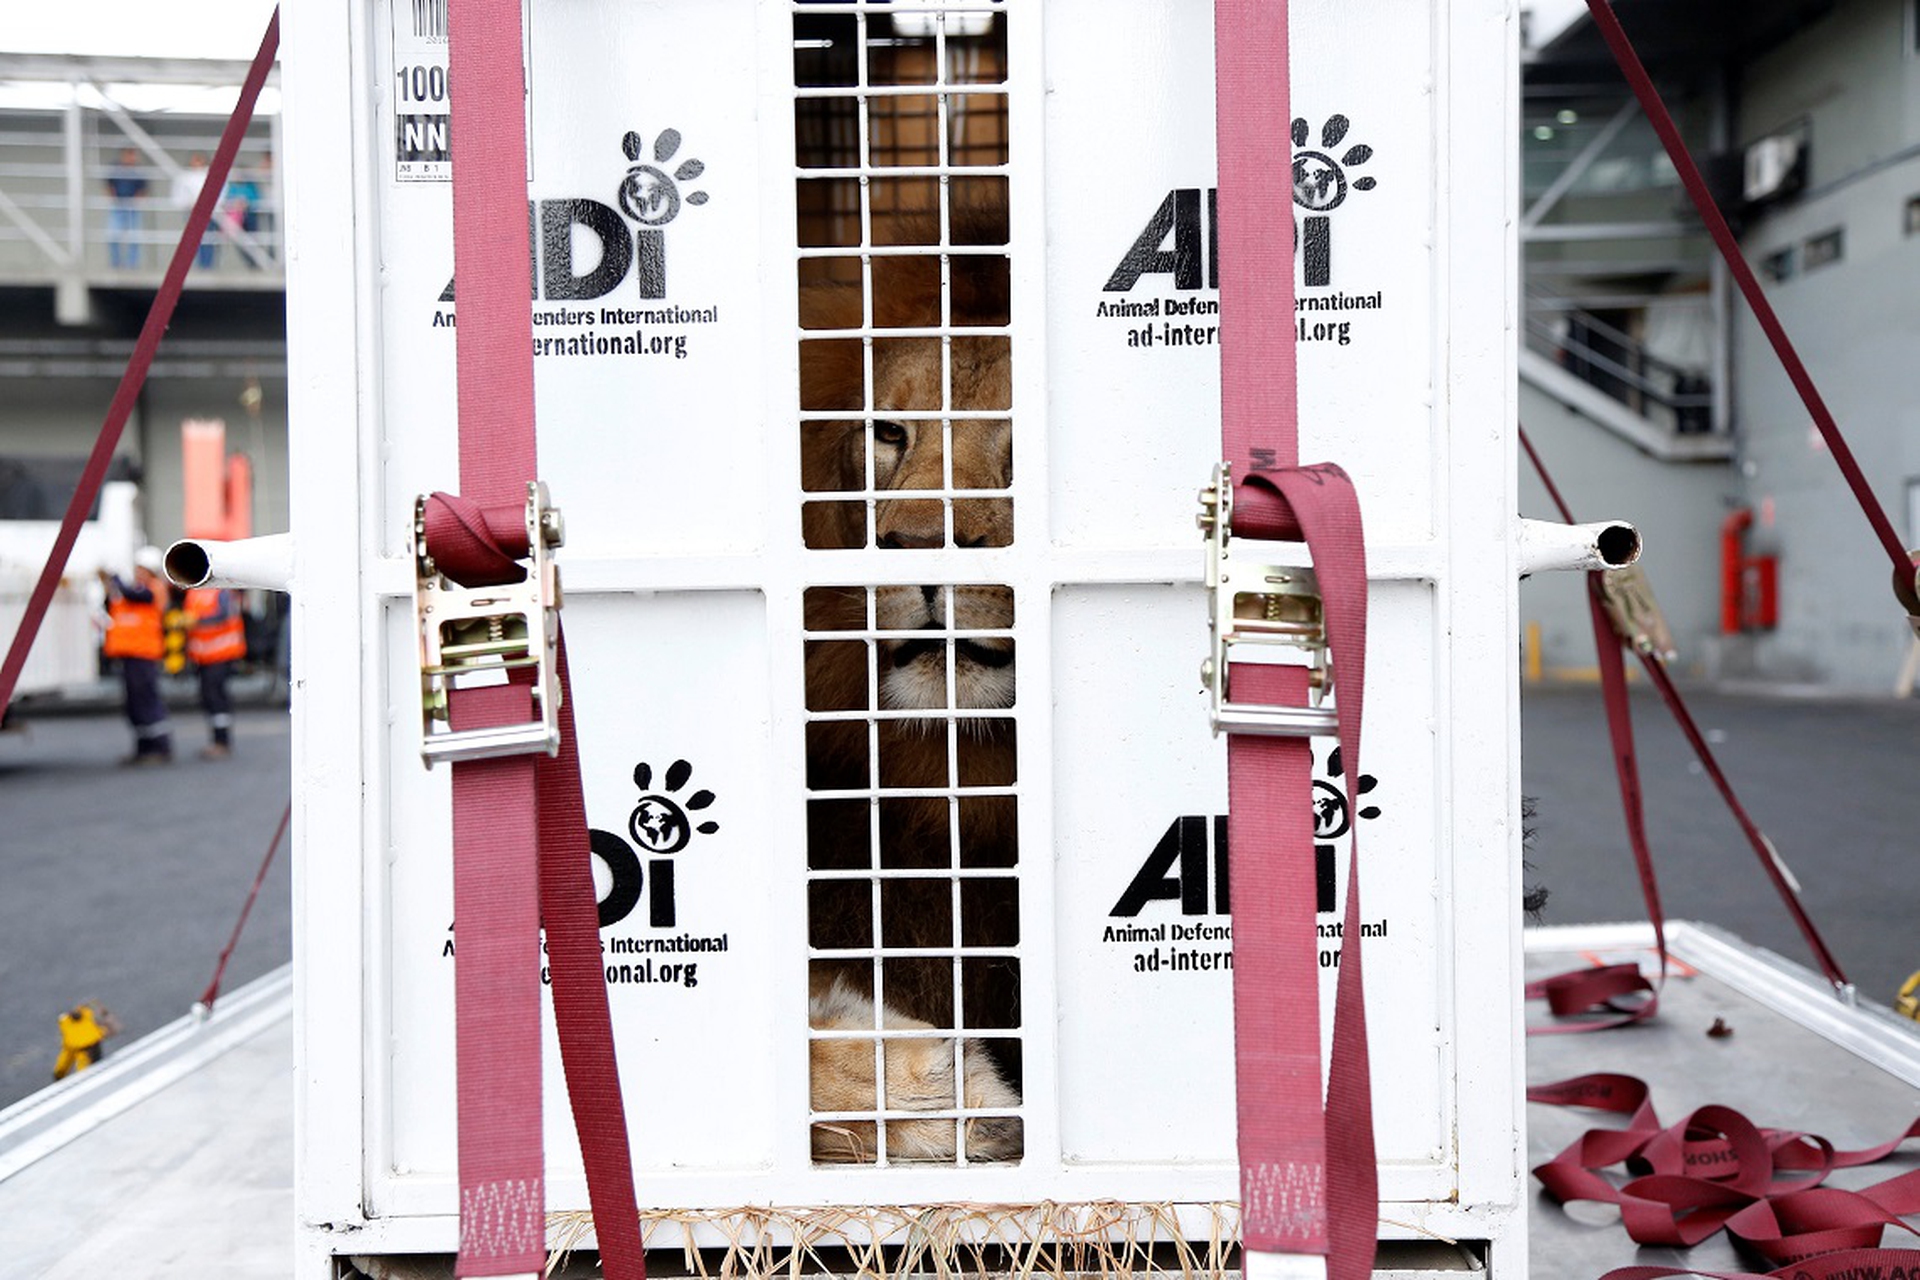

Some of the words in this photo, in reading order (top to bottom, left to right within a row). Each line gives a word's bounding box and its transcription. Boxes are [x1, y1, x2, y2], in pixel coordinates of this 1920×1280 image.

[532, 307, 596, 326] enders
[600, 304, 718, 325] International
[1096, 297, 1160, 318] Animal
[1164, 296, 1220, 316] Defen
[532, 329, 688, 359] ernational.org
[610, 932, 728, 954] International
[1102, 922, 1166, 943] Animal
